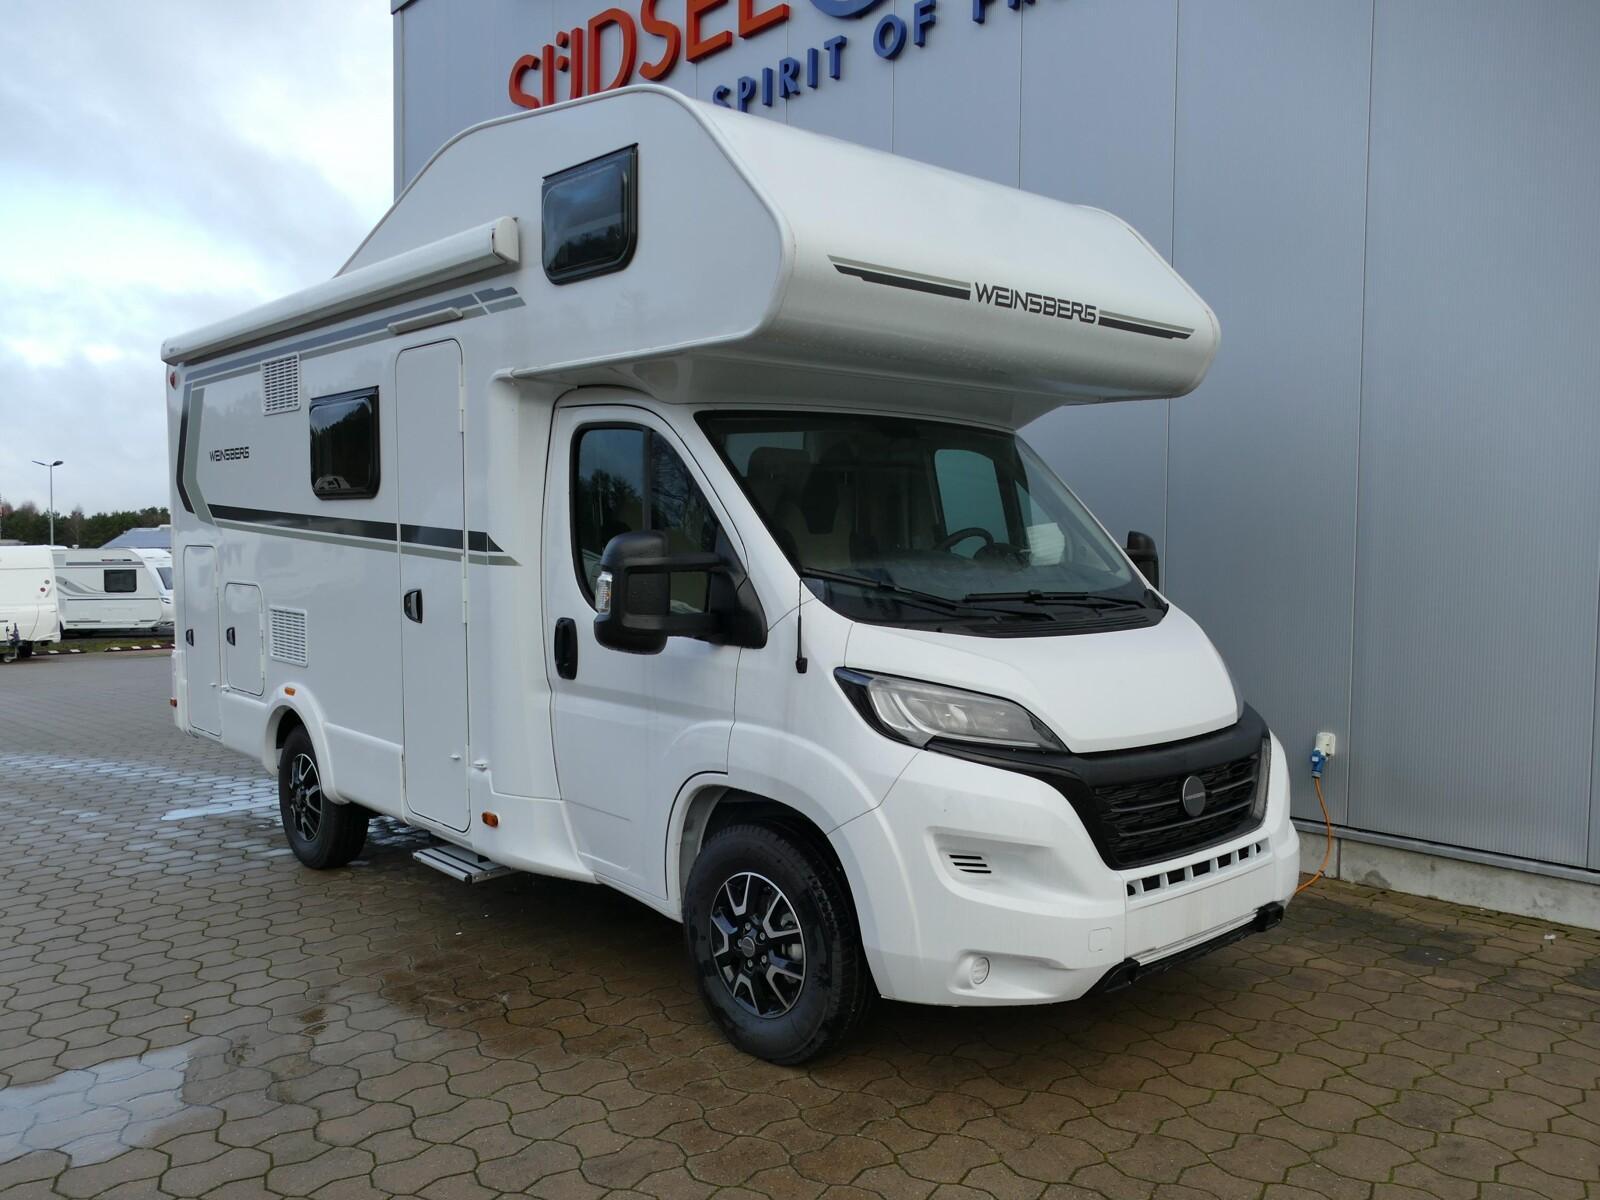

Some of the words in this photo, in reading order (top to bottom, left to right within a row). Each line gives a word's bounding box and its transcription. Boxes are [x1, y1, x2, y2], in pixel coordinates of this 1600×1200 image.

[712, 35, 847, 113] SPIRIT
[873, 0, 936, 60] OF
[975, 281, 1097, 324] WEINSBERG
[209, 446, 249, 461] WEINSBERG
